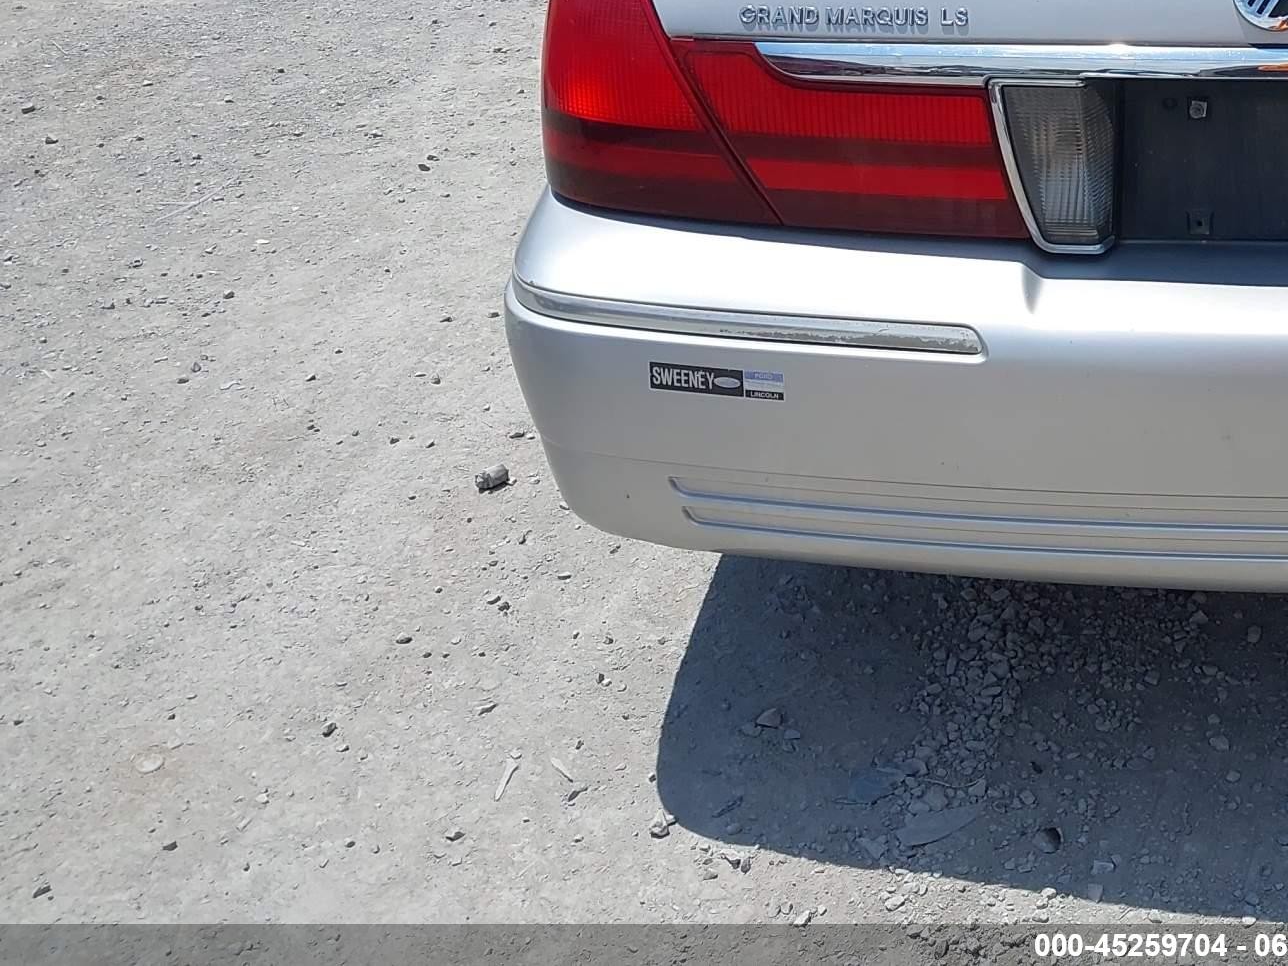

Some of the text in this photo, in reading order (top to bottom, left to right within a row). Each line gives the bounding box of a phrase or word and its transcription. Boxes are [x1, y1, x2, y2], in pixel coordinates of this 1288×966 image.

[739, 4, 969, 27] GRAND MARQUIS LS
[651, 366, 716, 390] SWEENEY
[750, 390, 780, 400] LINCOLN
